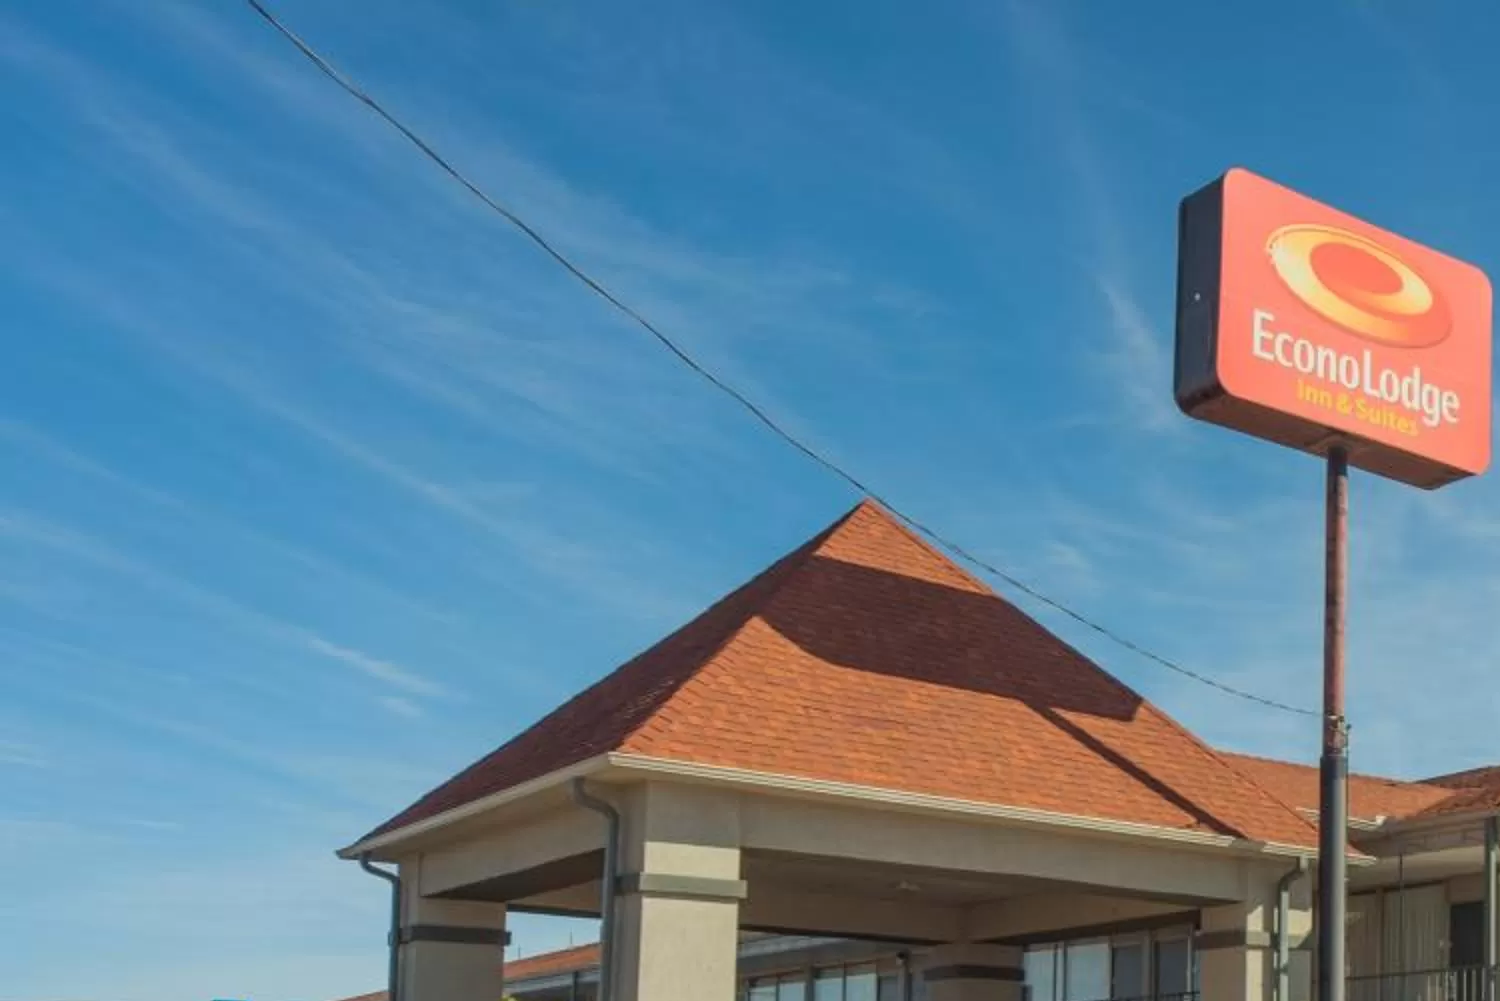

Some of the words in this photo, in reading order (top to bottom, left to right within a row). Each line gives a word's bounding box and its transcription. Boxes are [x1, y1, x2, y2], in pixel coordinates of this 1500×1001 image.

[1253, 308, 1460, 427] EconoLodge
[1298, 380, 1333, 407] Inn
[1338, 396, 1352, 414] &
[1356, 397, 1419, 437] Suites
